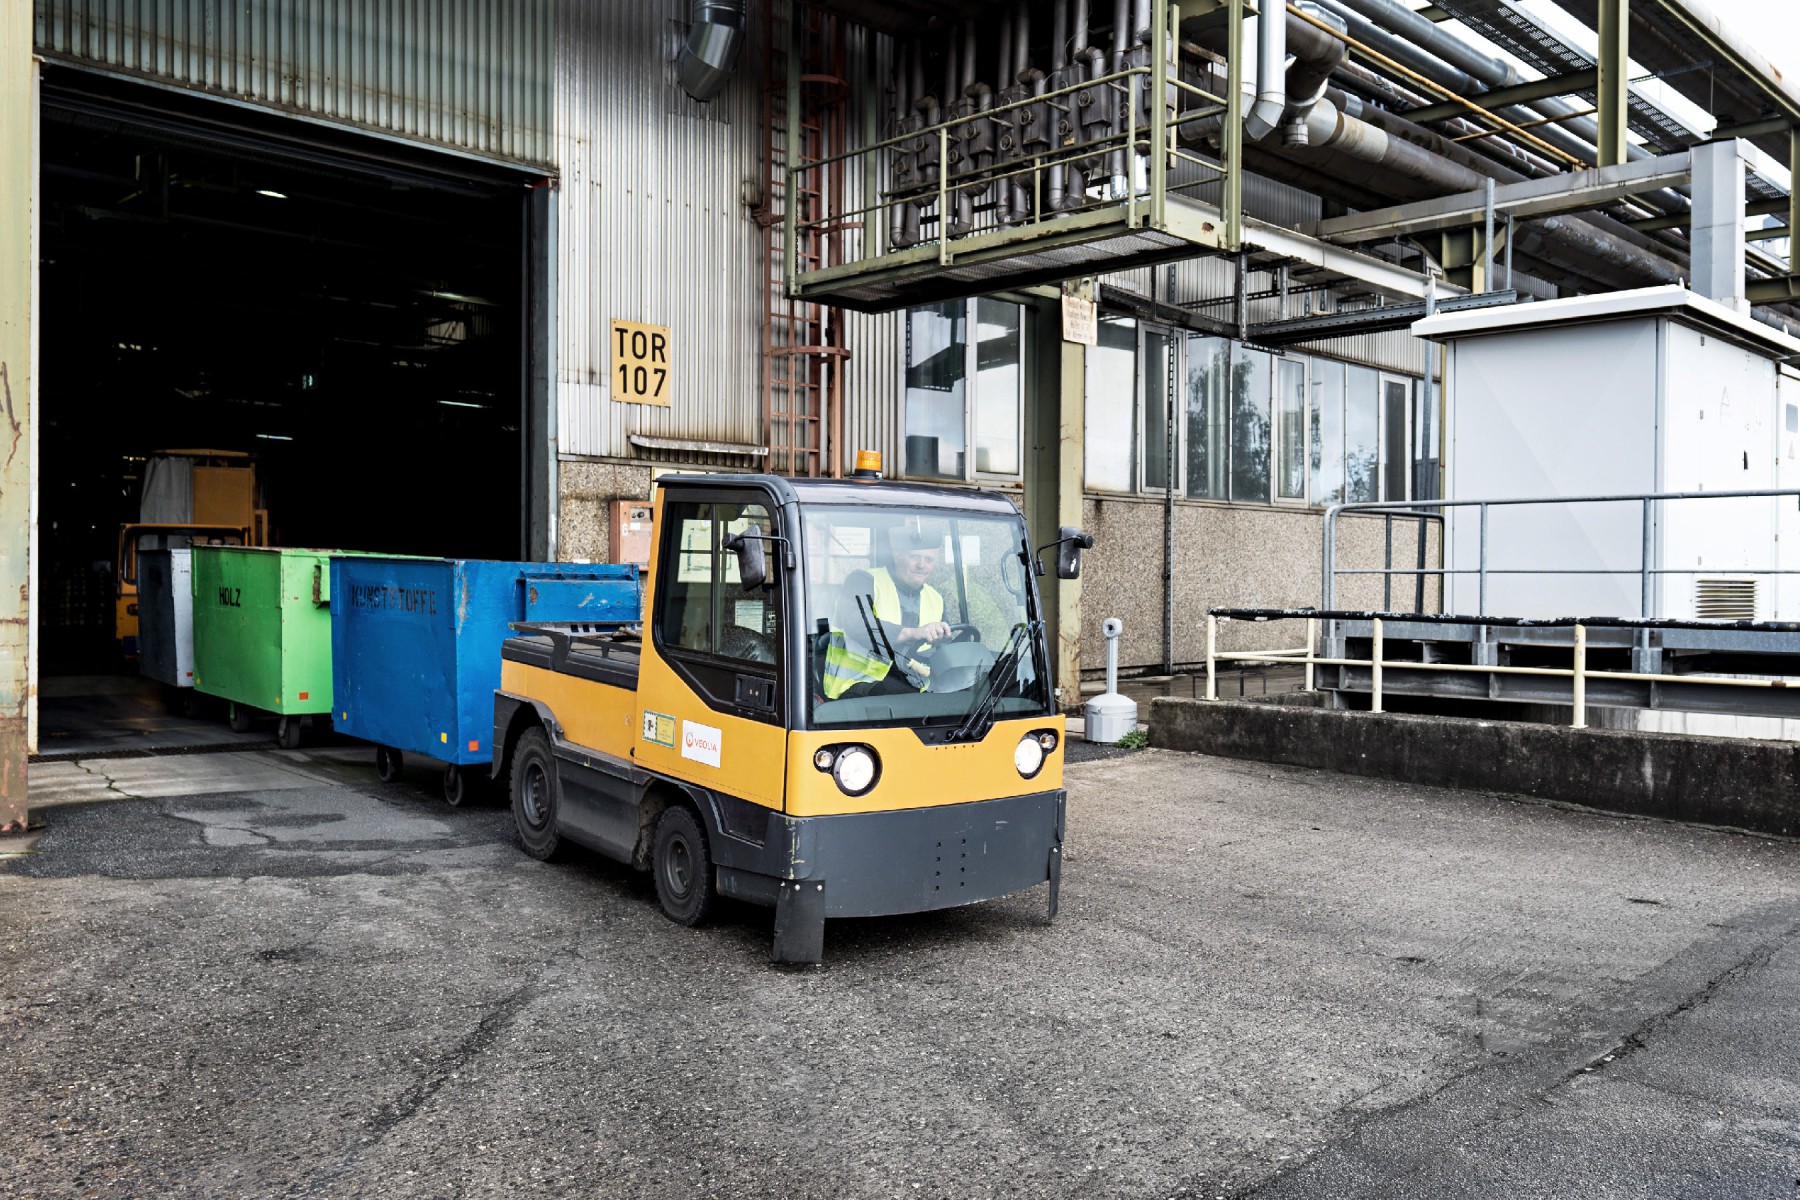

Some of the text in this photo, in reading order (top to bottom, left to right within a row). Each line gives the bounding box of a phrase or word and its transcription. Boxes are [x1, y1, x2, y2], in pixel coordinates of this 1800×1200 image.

[614, 327, 666, 363] TOR
[618, 364, 666, 397] 107
[218, 586, 241, 608] HOLZ
[351, 585, 437, 616] KUNSTSTOFFE
[694, 738, 718, 753] VEOLIA
